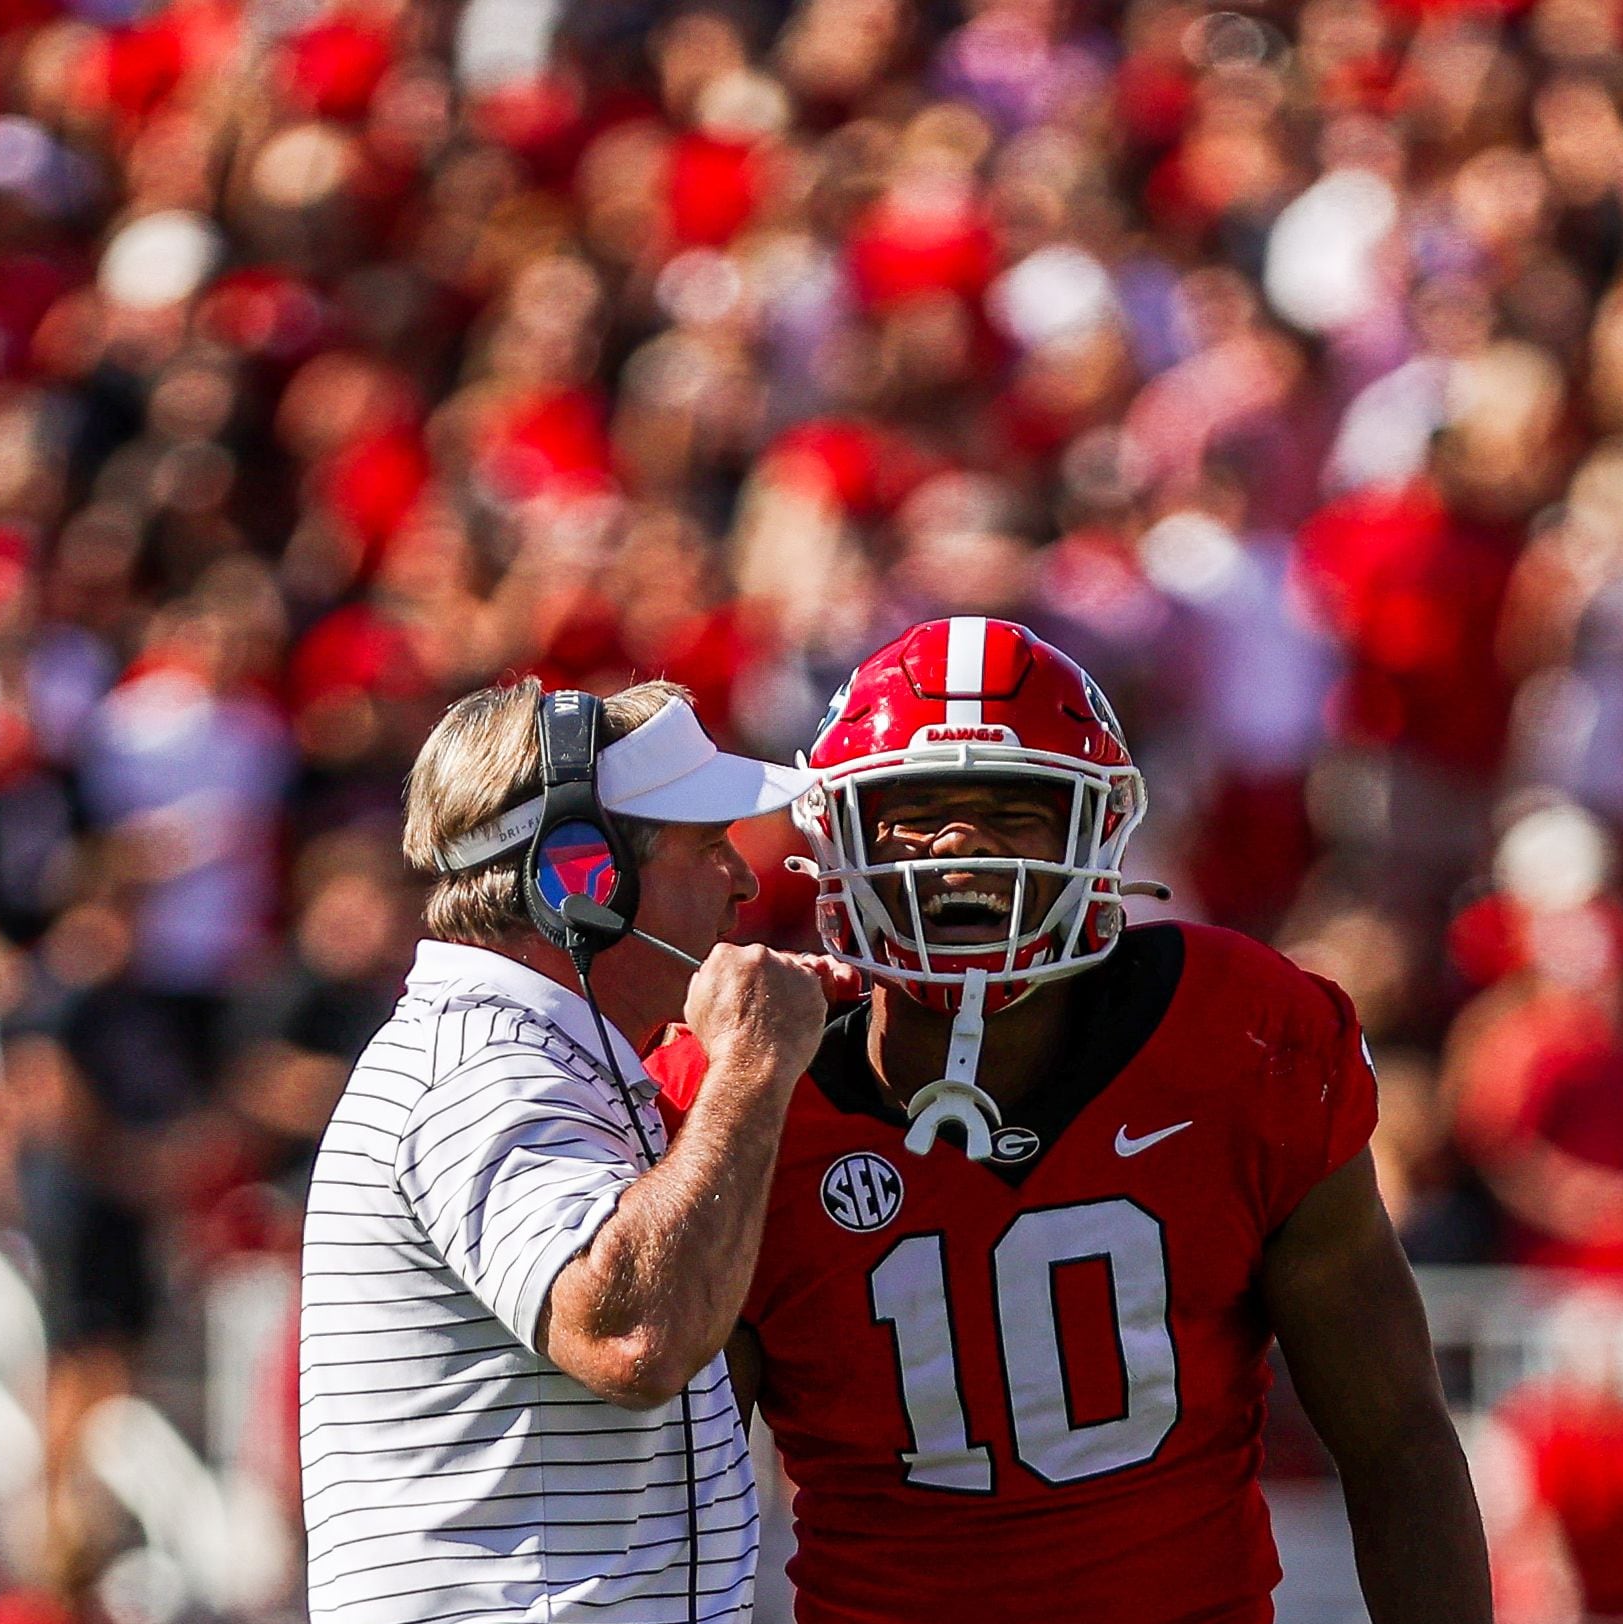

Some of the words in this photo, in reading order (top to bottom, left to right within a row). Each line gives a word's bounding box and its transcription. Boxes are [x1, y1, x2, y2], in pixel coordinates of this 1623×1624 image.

[927, 727, 1005, 742] DAWGS
[826, 1156, 898, 1227] SEC
[867, 1194, 1182, 1495] 10
